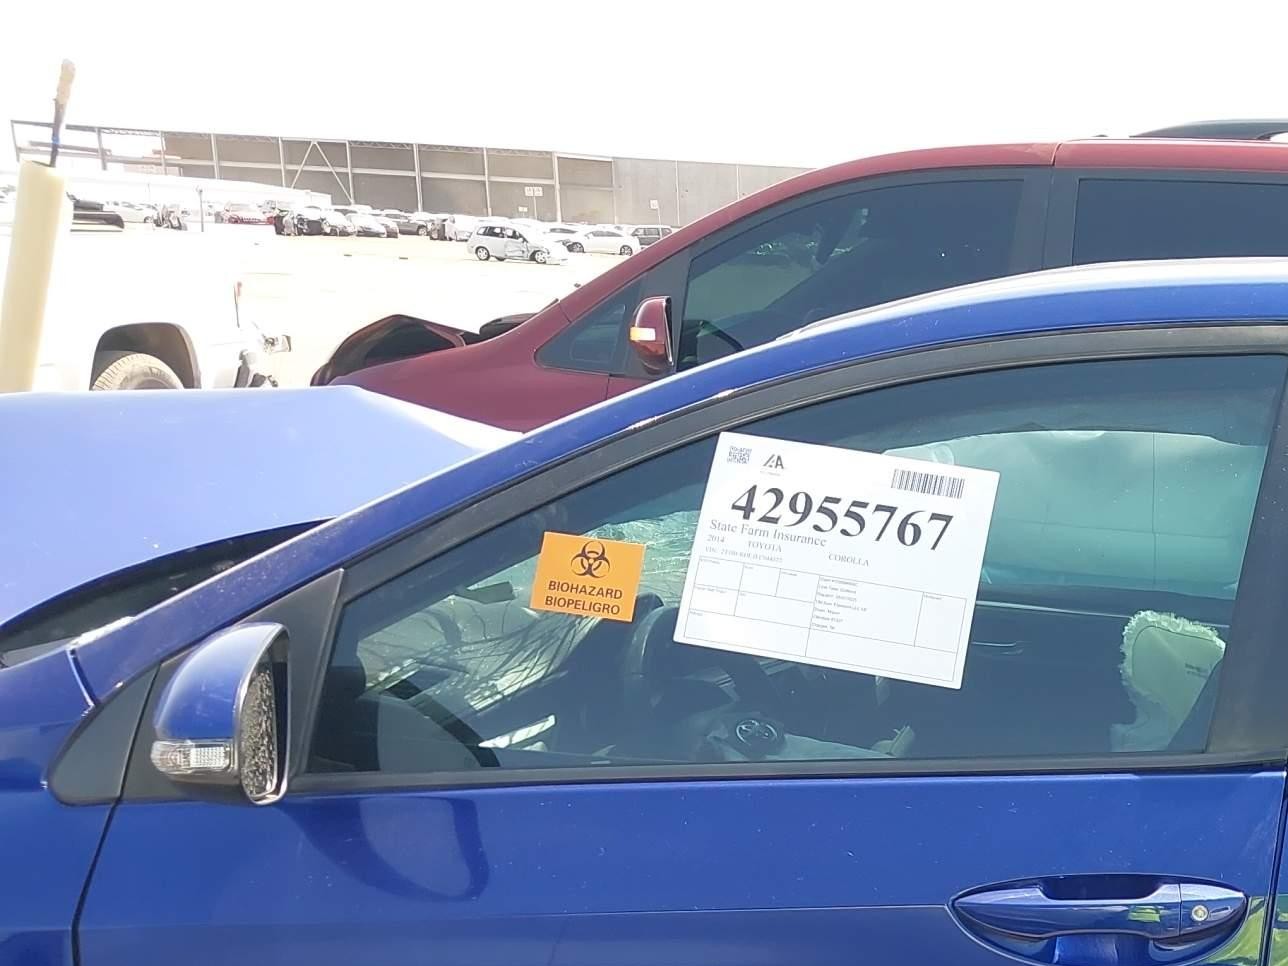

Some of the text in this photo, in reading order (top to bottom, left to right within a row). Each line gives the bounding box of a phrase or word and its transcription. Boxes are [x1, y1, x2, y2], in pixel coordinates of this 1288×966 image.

[731, 484, 954, 551] 42955767
[709, 519, 828, 547] State Farm Insurance
[548, 581, 622, 599] BIOHAZARD
[545, 596, 620, 615] BIOPELIGRO
